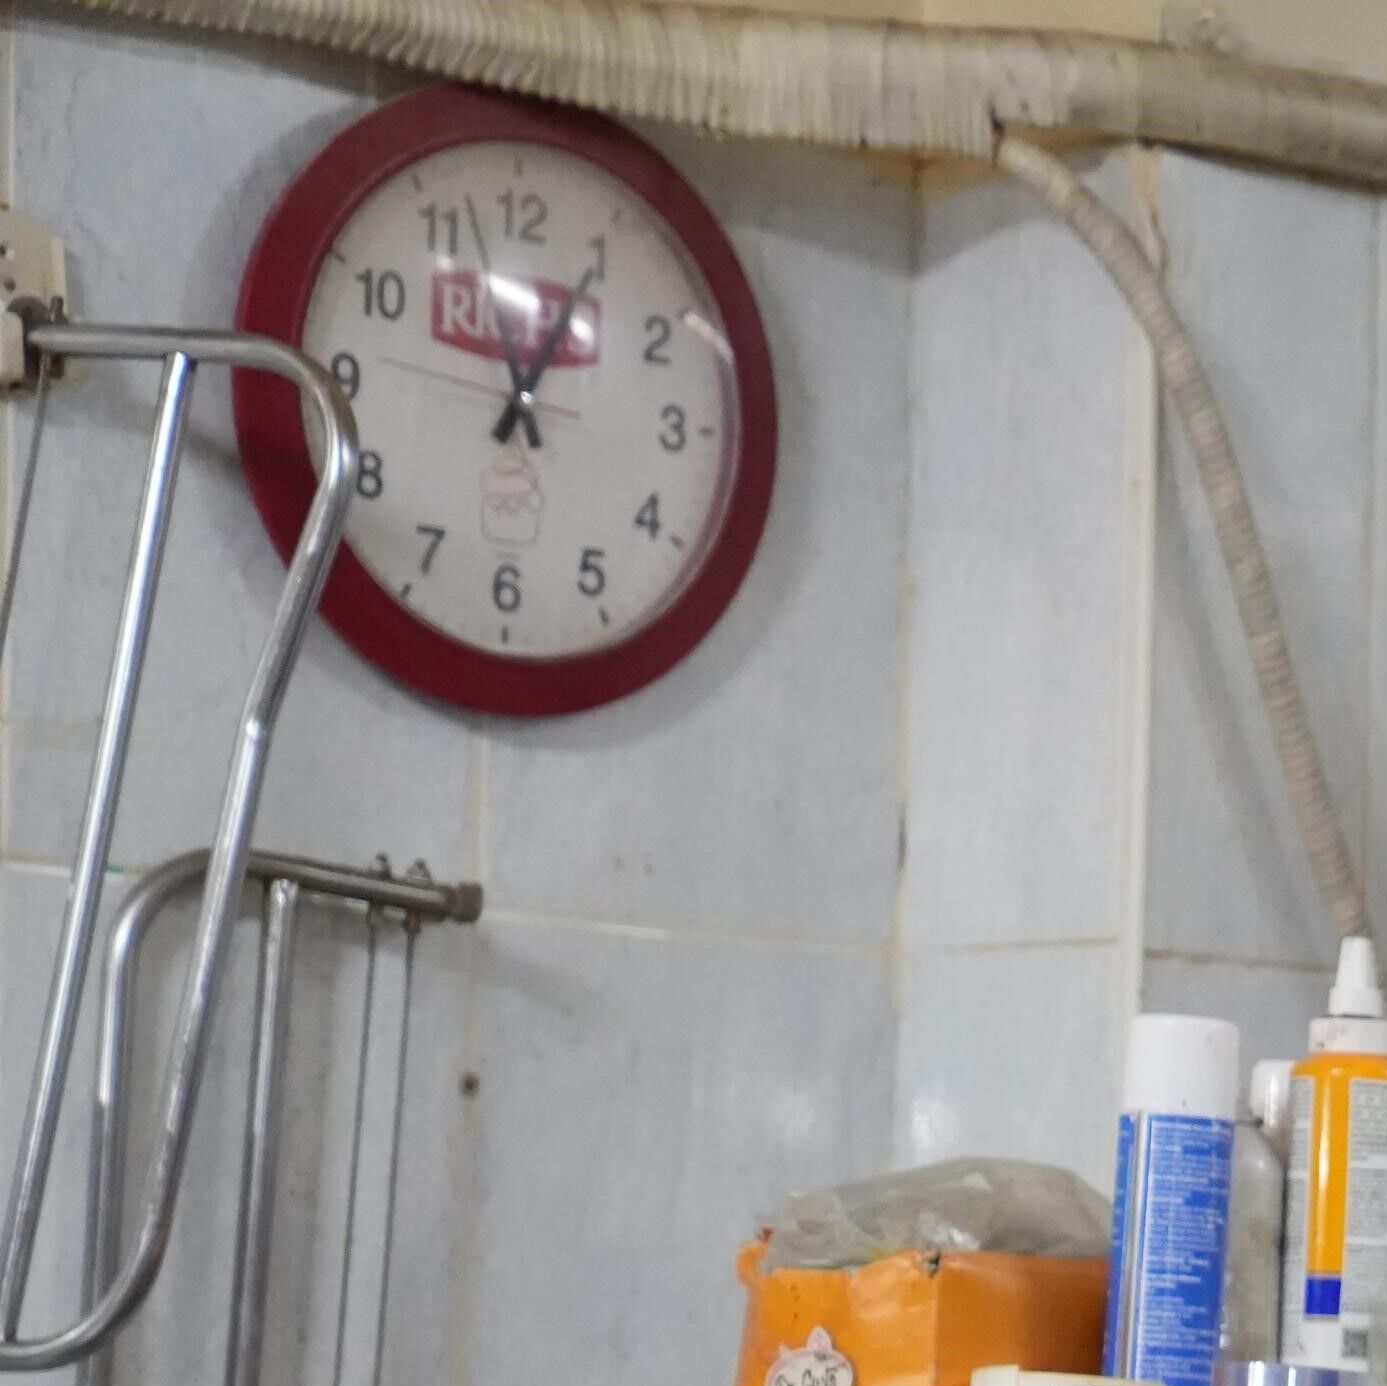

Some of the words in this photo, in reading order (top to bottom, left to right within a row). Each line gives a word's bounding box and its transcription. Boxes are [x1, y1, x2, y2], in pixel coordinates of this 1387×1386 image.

[419, 202, 460, 257] 11
[497, 193, 548, 244] 12
[587, 234, 606, 282] 1
[355, 271, 406, 321] 10
[643, 316, 673, 365] 2
[330, 352, 362, 400] 9
[659, 404, 688, 453] 3
[355, 450, 384, 499] 8
[633, 493, 662, 540] 4
[416, 526, 446, 575] 7
[577, 548, 606, 597] 5
[492, 566, 521, 613] 6
